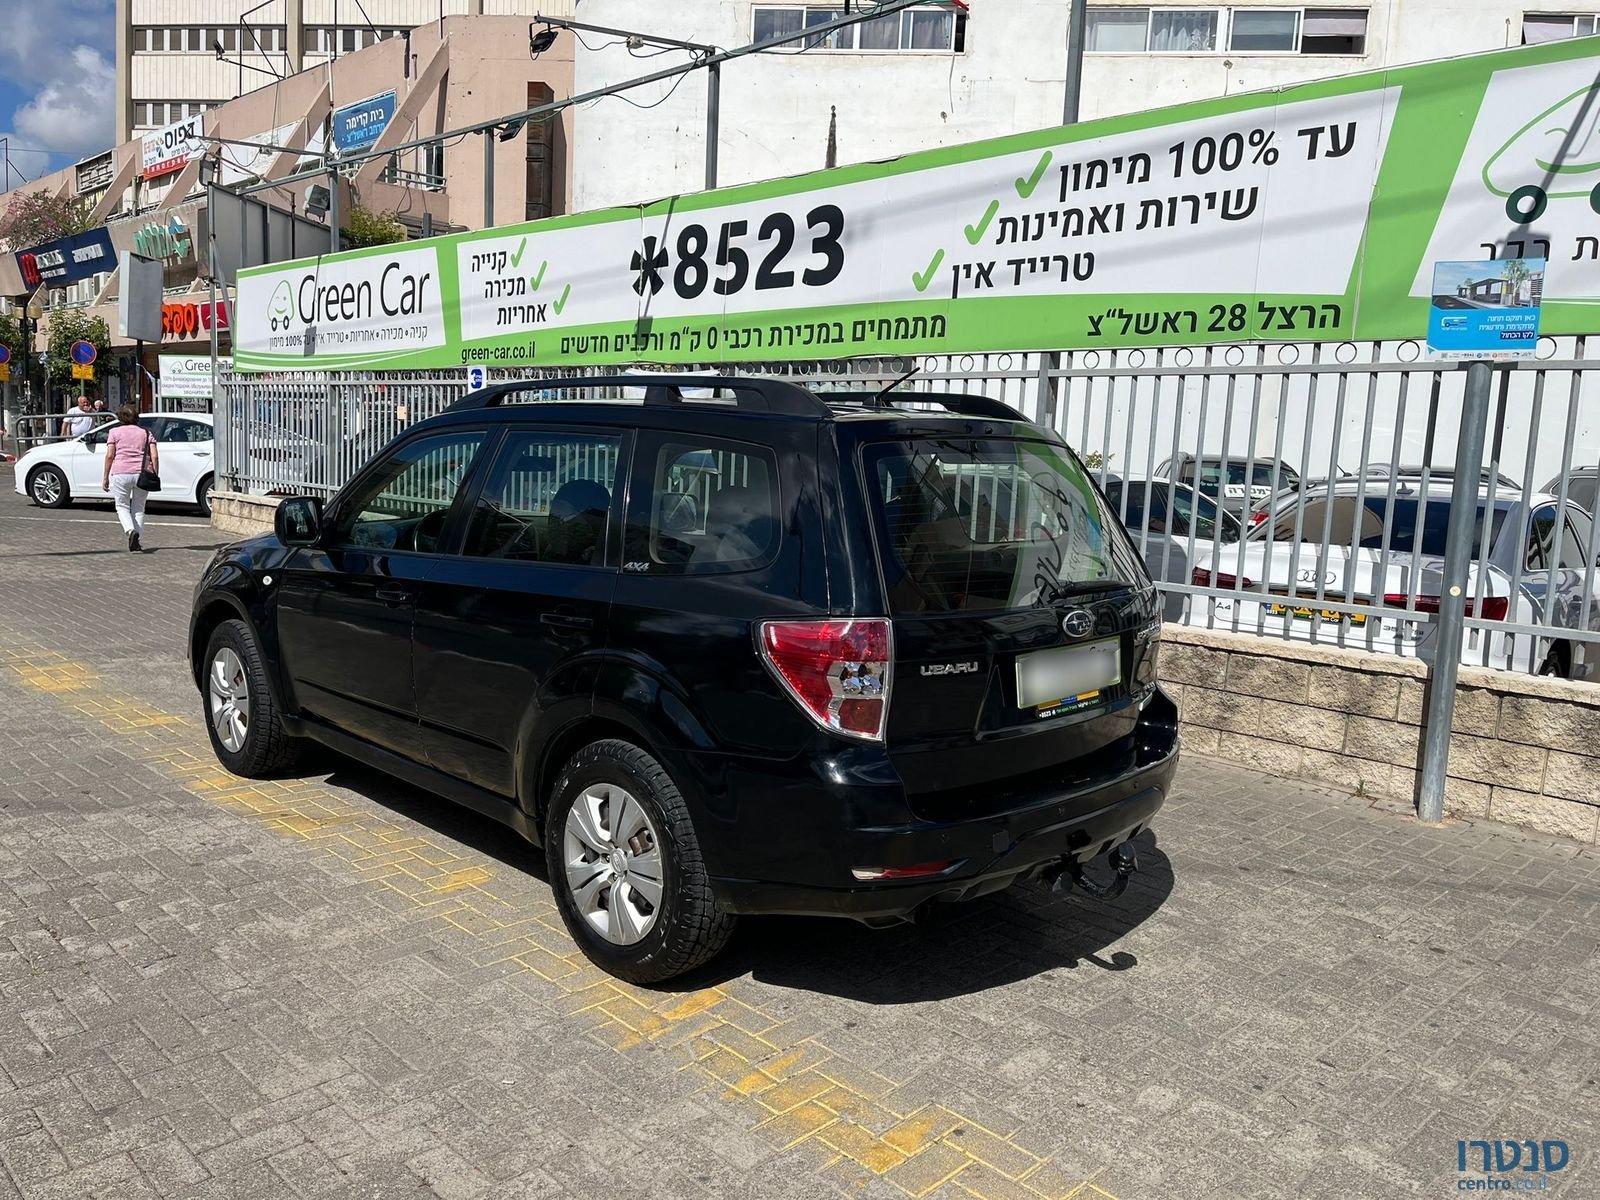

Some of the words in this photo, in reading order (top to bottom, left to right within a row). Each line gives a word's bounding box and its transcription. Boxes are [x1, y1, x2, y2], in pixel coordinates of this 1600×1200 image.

[370, 108, 384, 122] בית
[1297, 121, 1357, 160] עד
[1168, 128, 1279, 179] 100%
[1059, 150, 1151, 202] מימון
[1135, 186, 1259, 229] שירות
[995, 202, 1125, 246] ואמינות
[471, 251, 507, 274] קנייה
[1006, 250, 1095, 287] טרייד
[484, 277, 526, 298] מכירה
[951, 261, 995, 299] אין
[298, 274, 372, 324] Green
[380, 262, 430, 317] Car
[496, 303, 548, 325] אחריות
[1207, 304, 1247, 332] 28
[1258, 301, 1342, 330] הרצל
[327, 332, 345, 343] טרייד
[349, 330, 375, 343] אחריות
[381, 327, 404, 341] מכירה
[409, 326, 428, 342] קניה
[707, 325, 717, 350] 0
[723, 325, 763, 349] רכבי
[768, 321, 844, 348] במכירת
[852, 314, 946, 342] מתמחים
[269, 336, 284, 351] מימון
[285, 335, 302, 347] 100%
[461, 341, 536, 364] green-car.co.il
[560, 335, 609, 354] חדשים
[614, 332, 664, 352] ורכבים
[185, 359, 211, 372] Gree
[1215, 601, 1231, 610] A4
